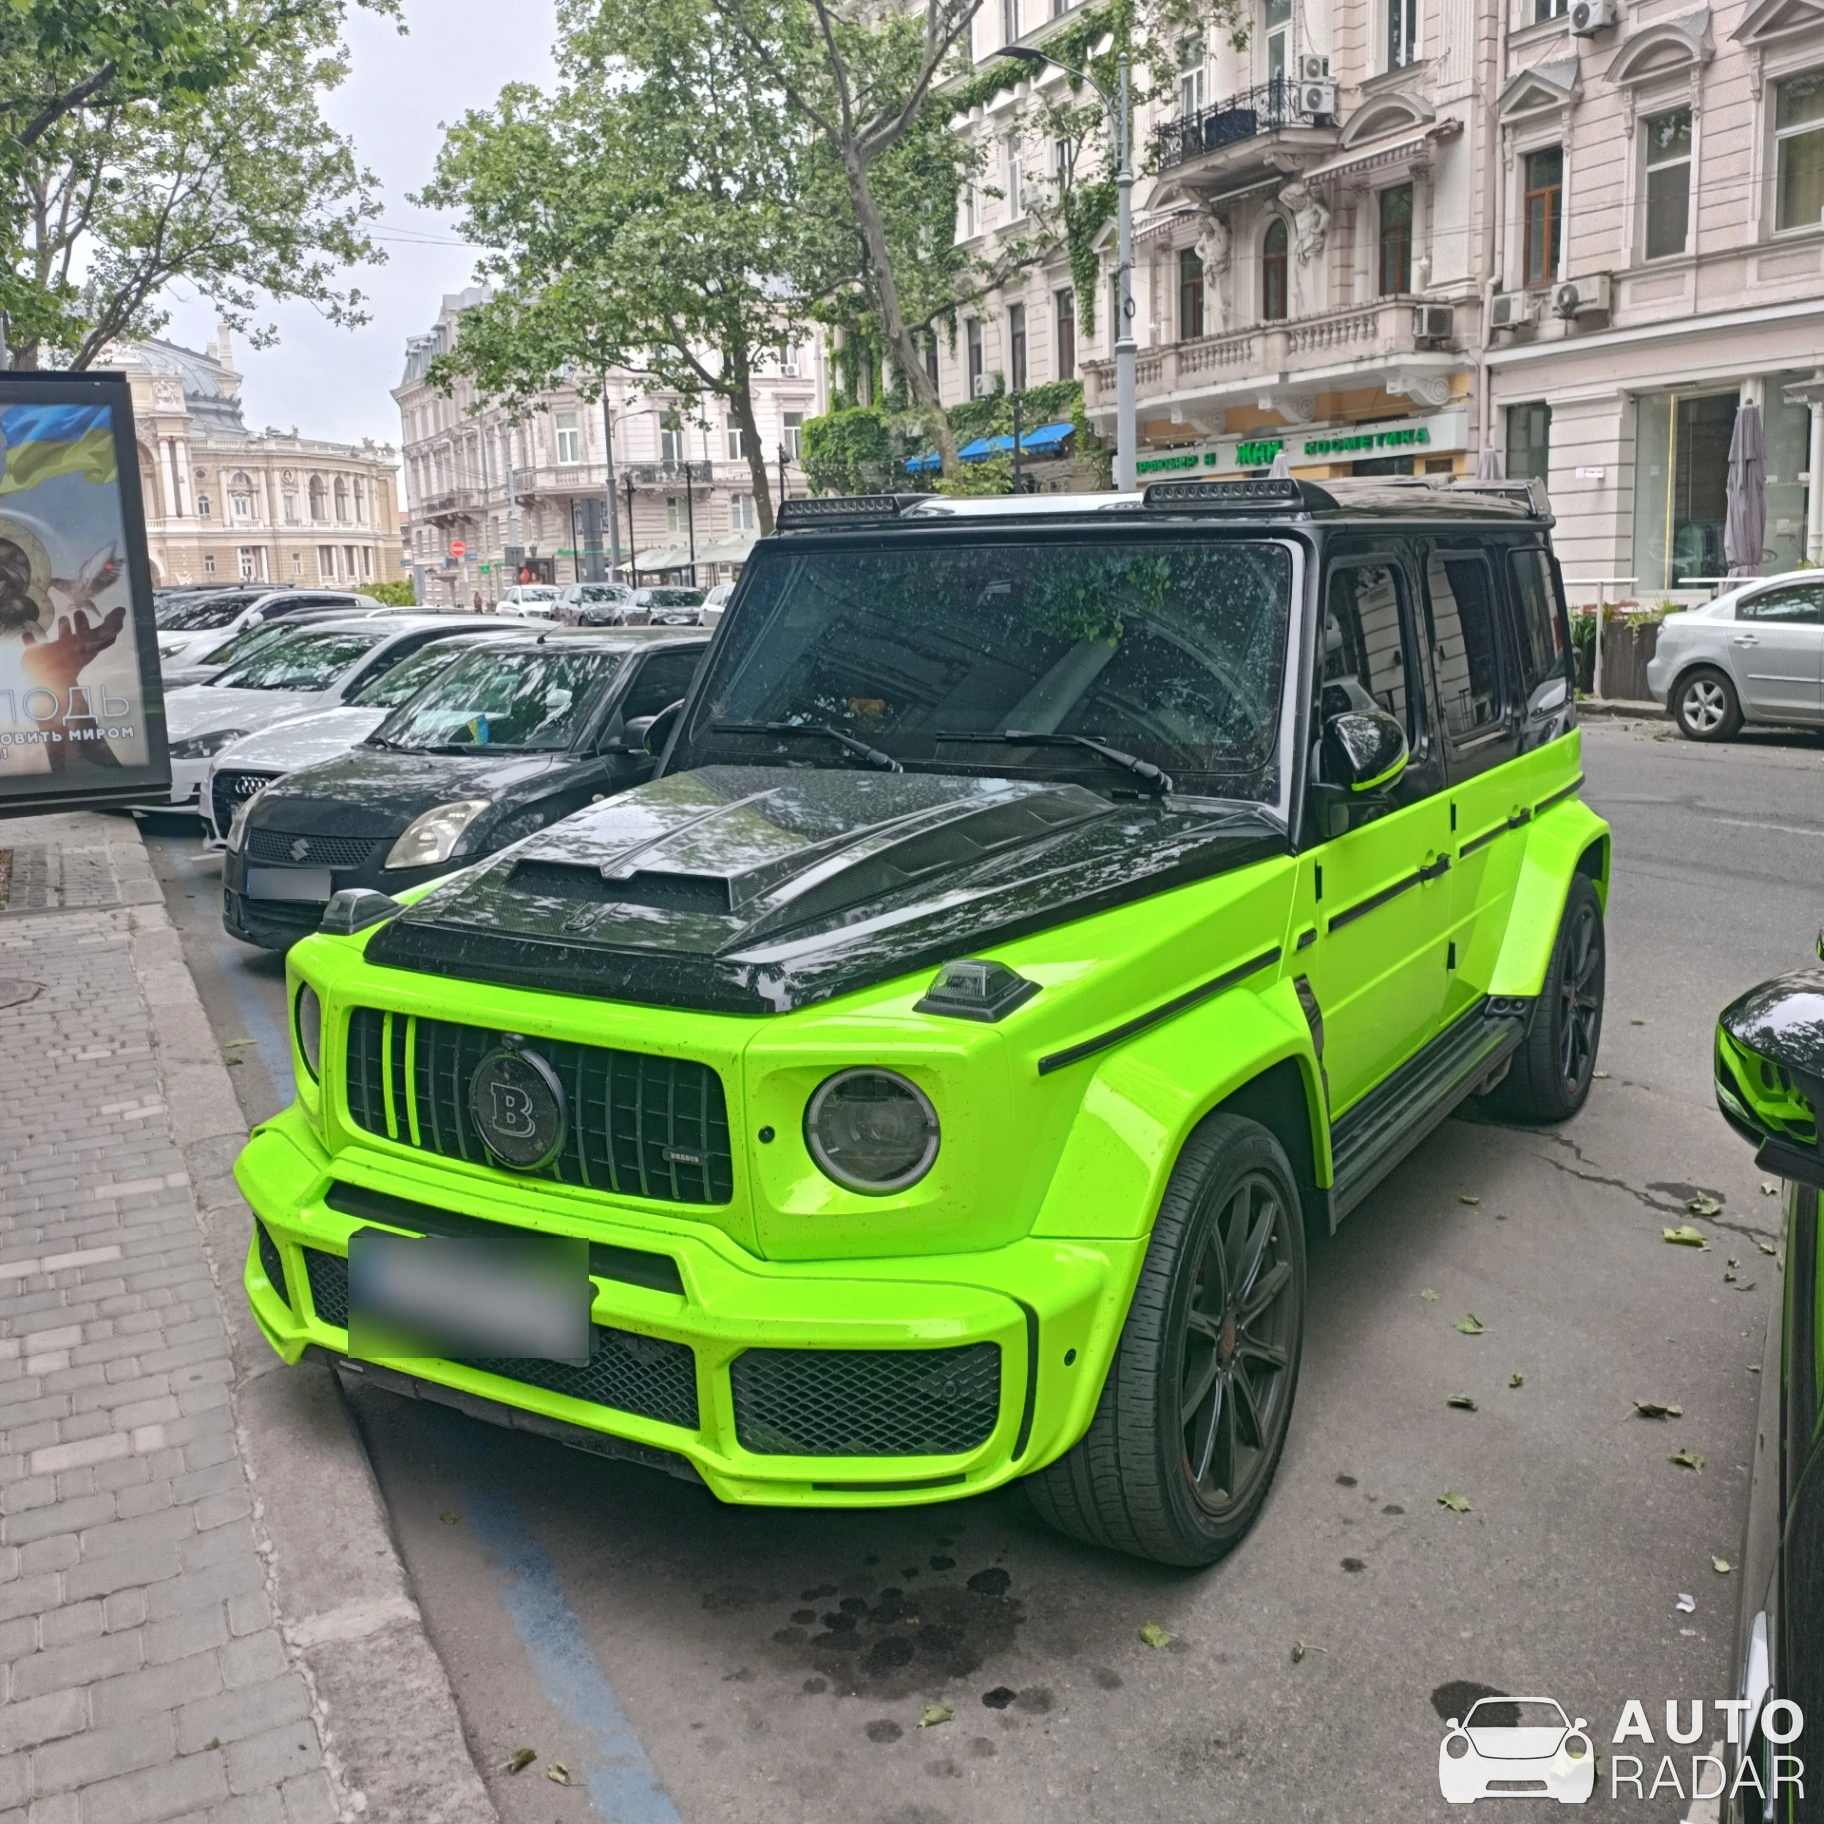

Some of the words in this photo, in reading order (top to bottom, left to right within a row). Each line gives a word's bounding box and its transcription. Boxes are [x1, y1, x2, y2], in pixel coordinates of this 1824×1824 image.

[1304, 427, 1431, 455] КОСМЕТИКА
[68, 727, 134, 742] МИРОМ
[491, 1082, 536, 1138] B
